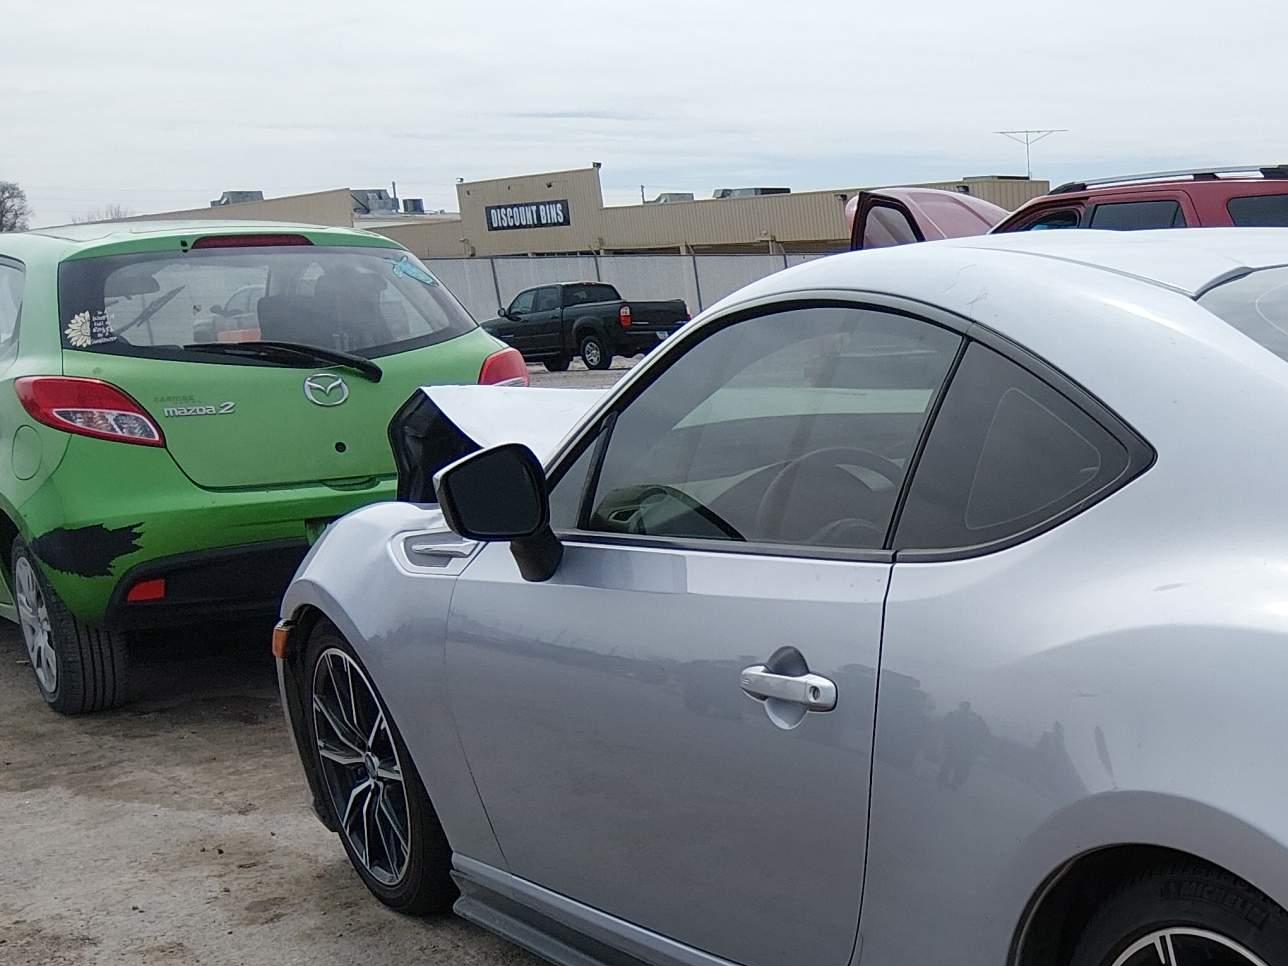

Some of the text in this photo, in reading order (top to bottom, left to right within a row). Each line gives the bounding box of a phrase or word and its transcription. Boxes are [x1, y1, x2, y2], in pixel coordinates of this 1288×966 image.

[490, 203, 564, 227] DISCOUNT BINS
[219, 401, 235, 414] 2
